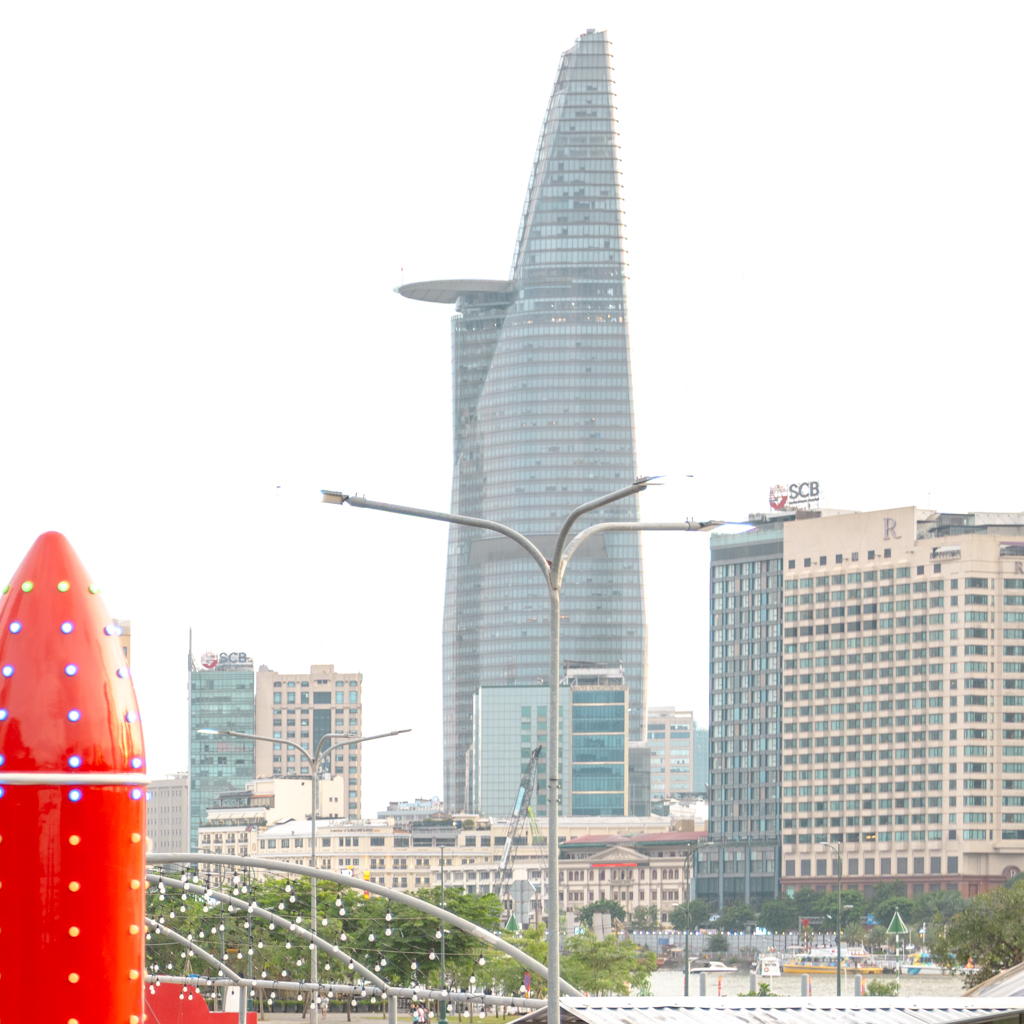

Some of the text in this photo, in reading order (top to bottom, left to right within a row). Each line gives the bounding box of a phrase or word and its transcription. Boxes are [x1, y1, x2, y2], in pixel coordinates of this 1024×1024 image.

[789, 481, 819, 499] SCB
[883, 517, 902, 540] R
[219, 652, 247, 663] SCB
